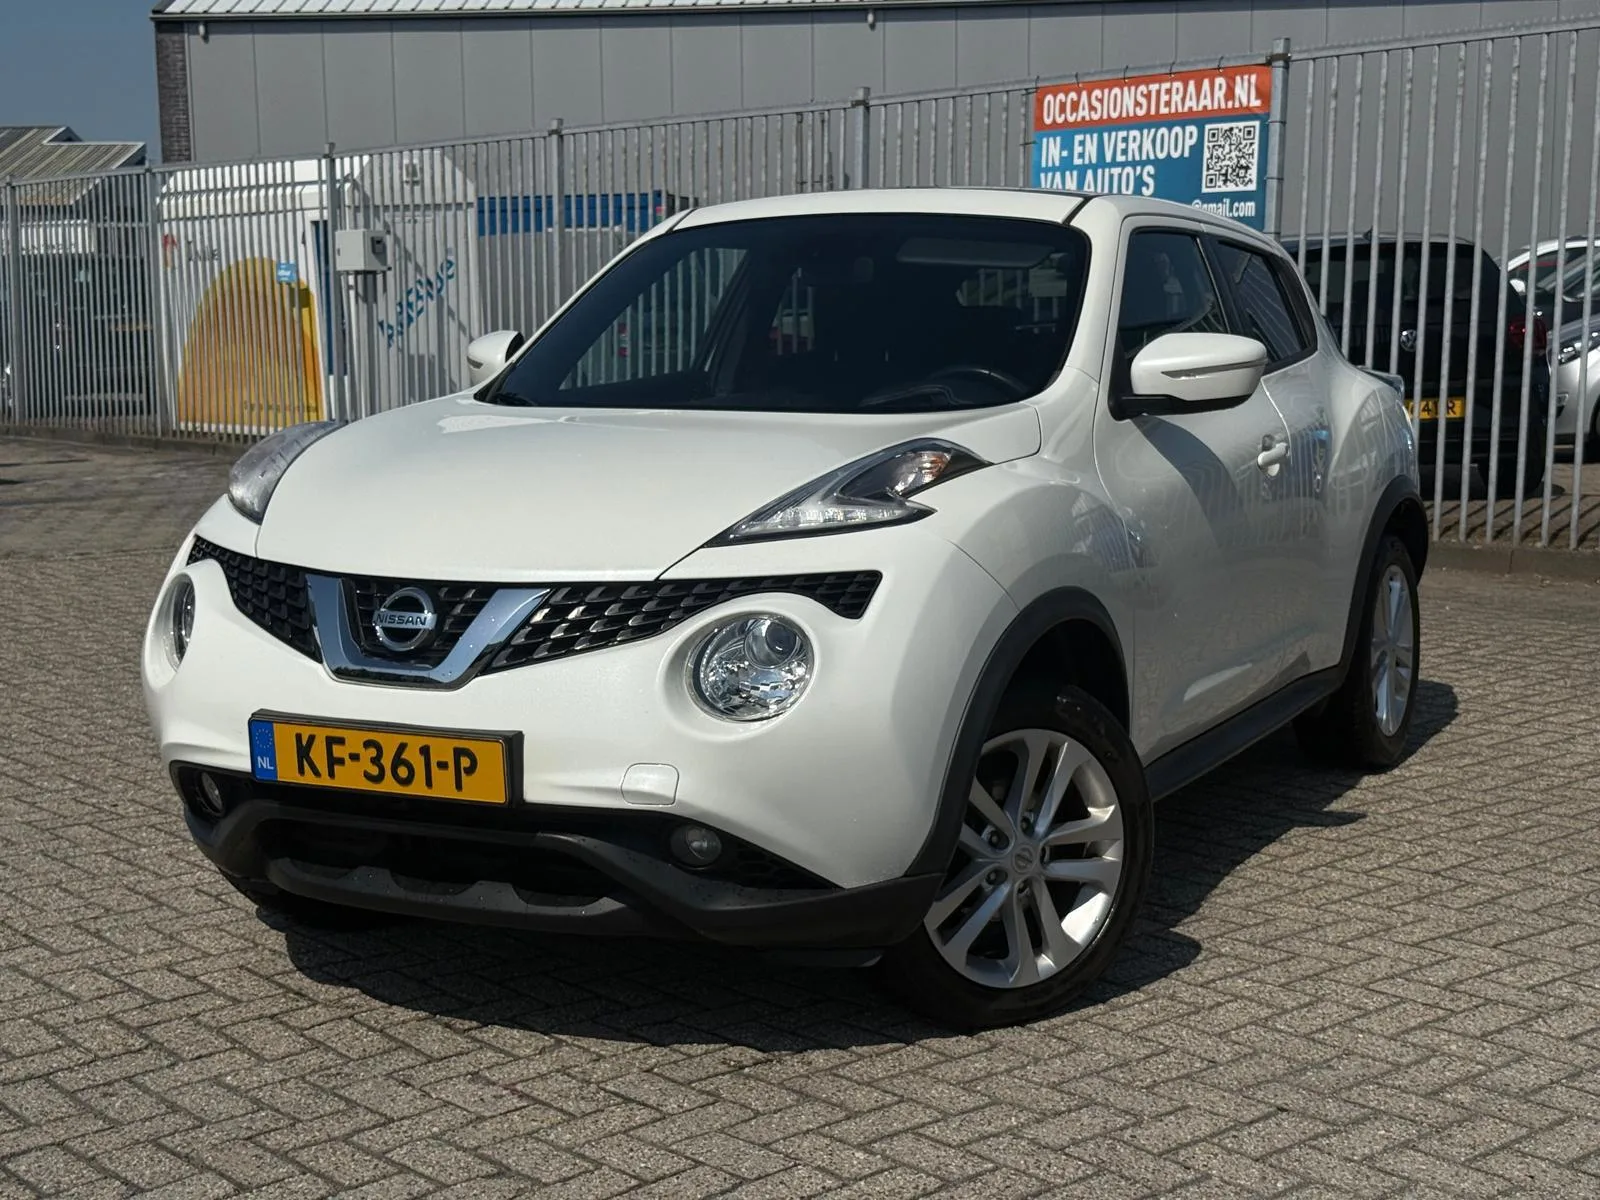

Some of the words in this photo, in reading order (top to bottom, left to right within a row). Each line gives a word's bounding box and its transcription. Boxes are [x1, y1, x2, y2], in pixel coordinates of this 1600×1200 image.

[1042, 73, 1261, 125] OCCASIONSTERAAR.NL
[1041, 136, 1068, 168] IN-
[1073, 133, 1098, 165] EN
[1103, 125, 1198, 163] VERKOOP
[1083, 165, 1155, 196] AUTO'S
[376, 612, 428, 627] NISSAN
[257, 755, 274, 770] NL
[294, 732, 479, 792] KF-361-P
